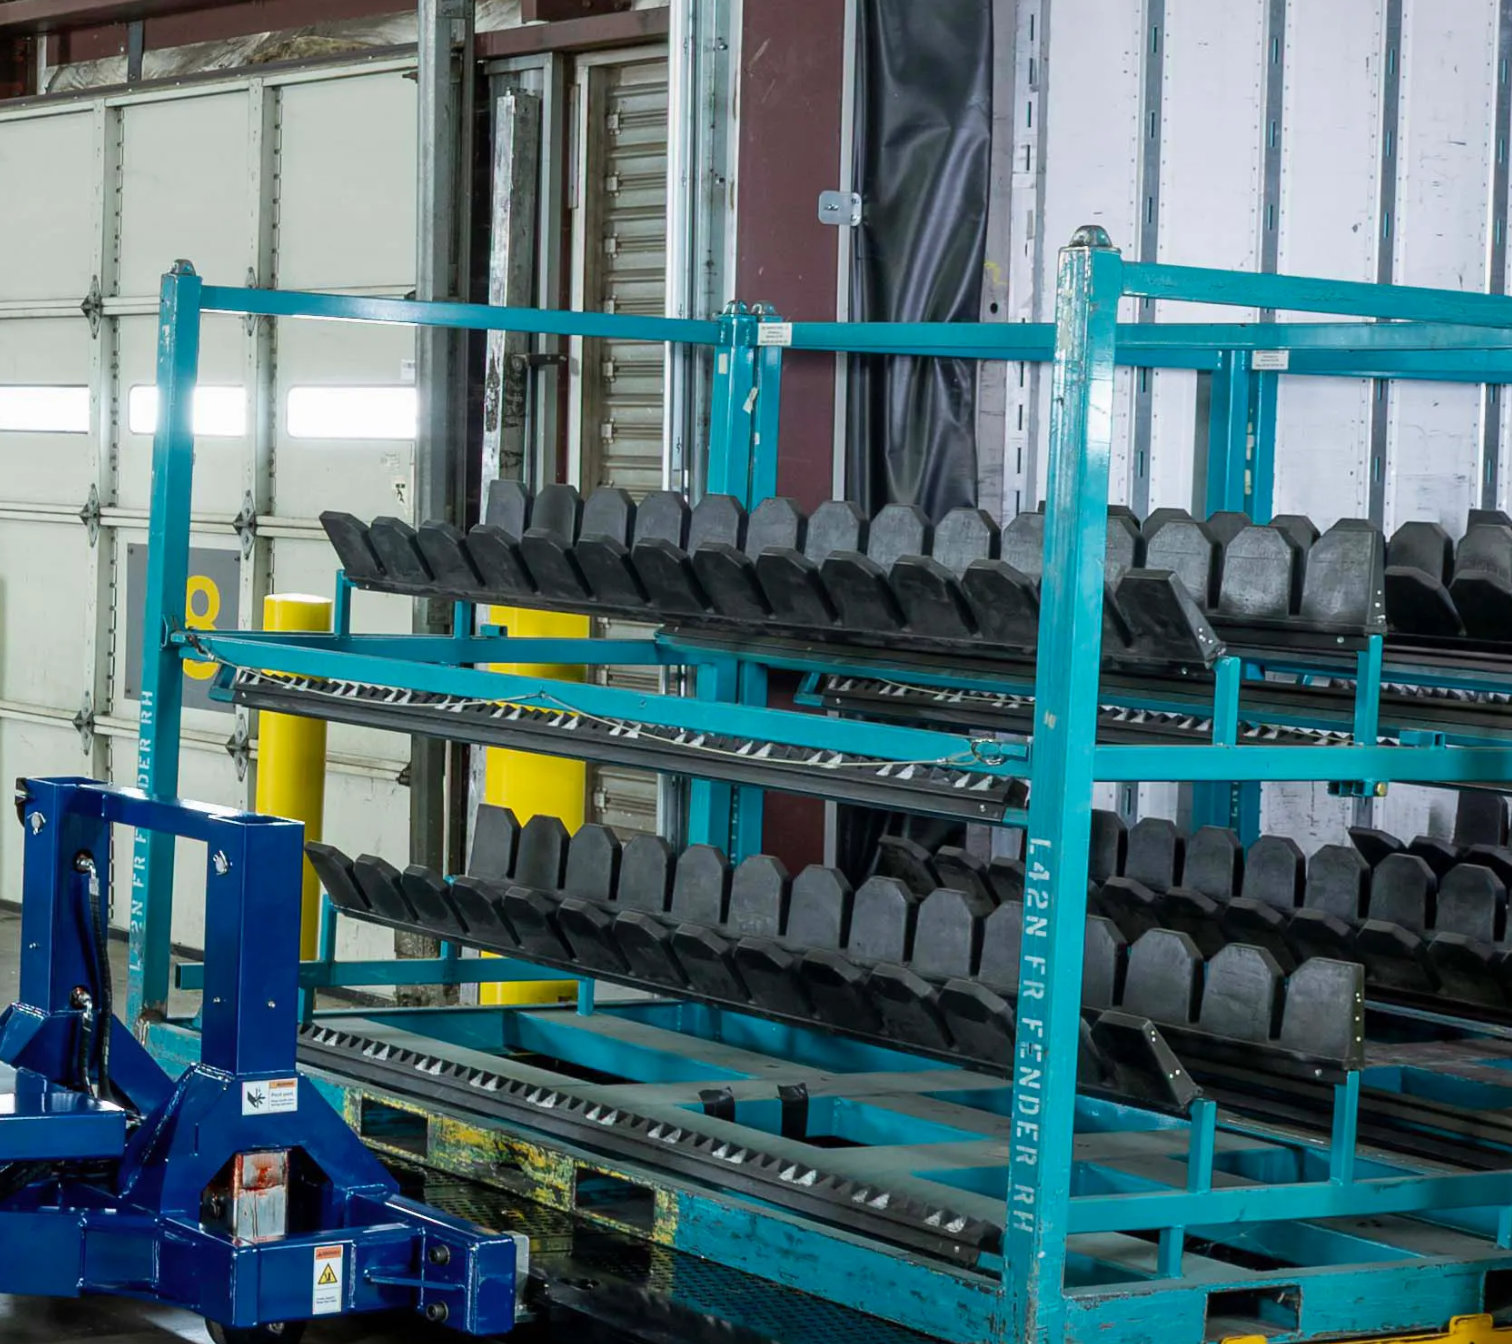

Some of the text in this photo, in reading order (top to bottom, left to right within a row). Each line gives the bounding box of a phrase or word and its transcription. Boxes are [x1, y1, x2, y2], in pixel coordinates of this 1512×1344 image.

[140, 691, 154, 723] RH
[1012, 837, 1052, 1234] L42N FR FENDER RH
